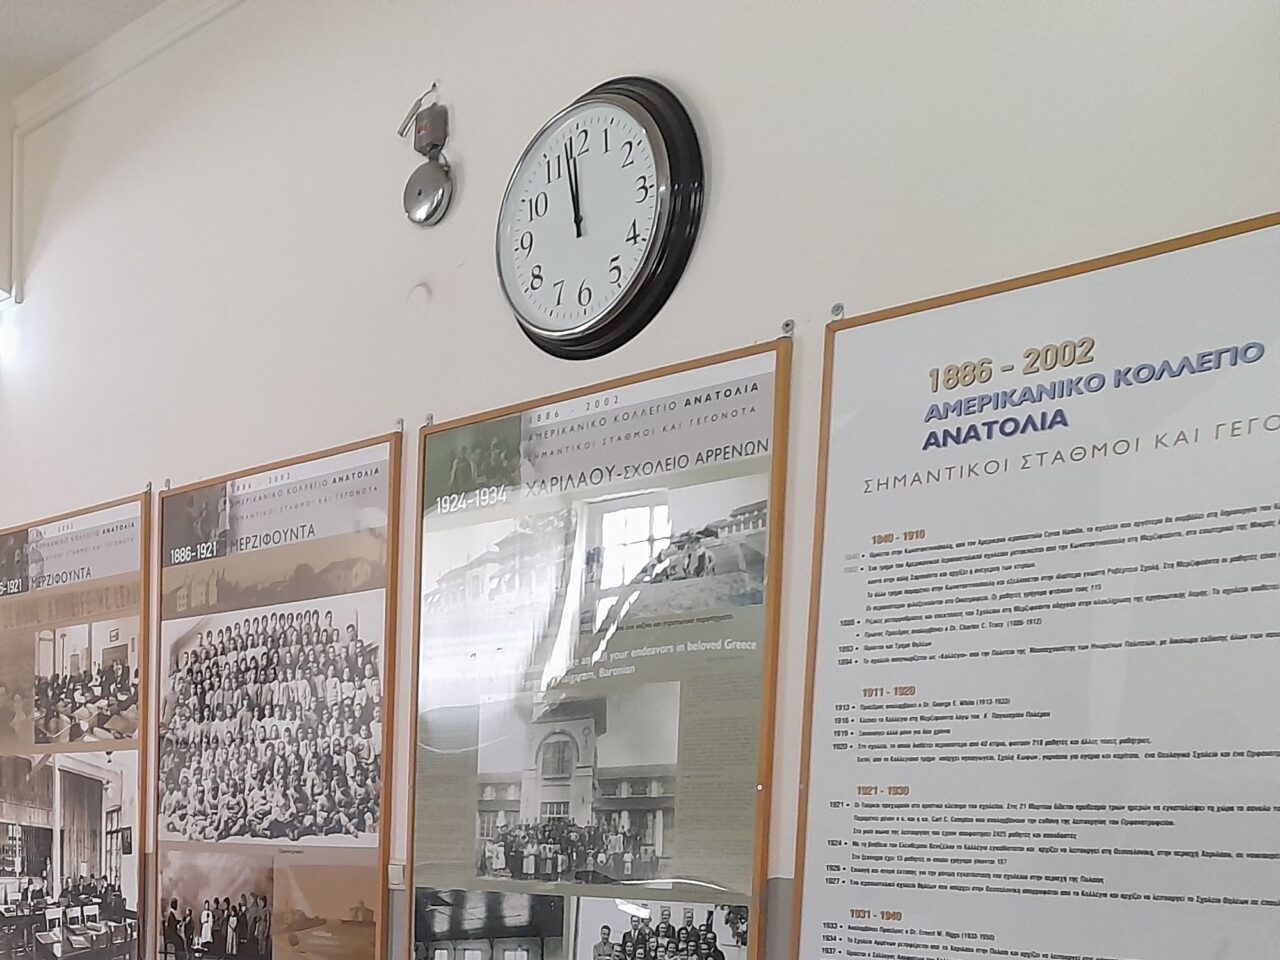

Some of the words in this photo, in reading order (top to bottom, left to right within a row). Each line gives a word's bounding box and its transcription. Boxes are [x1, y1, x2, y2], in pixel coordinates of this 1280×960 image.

[569, 127, 590, 160] 12
[602, 127, 610, 153] 1
[621, 140, 634, 168] 2
[546, 152, 562, 184] 11
[635, 176, 648, 204] 3
[527, 191, 548, 222] 10
[520, 231, 533, 259] 9
[625, 217, 640, 247] 4
[530, 264, 543, 290] 8
[609, 255, 622, 284] 5
[553, 279, 564, 306] 7
[578, 279, 592, 306] 6
[929, 357, 993, 392] 1886
[1023, 336, 1096, 375] 2002
[924, 370, 1105, 423] ΑΜΕΡΙΚΑΝΙΚΟ
[1113, 341, 1265, 389] ΚΟΛΛΕΓΙΟ
[586, 395, 619, 410] 2002
[614, 401, 677, 424] ΚΟΛΛΕΓΙΟ
[683, 382, 759, 407] ΑΝΑΤΟΛΙΑ
[922, 409, 1069, 451] ΑΝΑΤΟΛΙΑ
[694, 438, 769, 465] ΑΡΡΕΝΩΝ
[863, 458, 1009, 494] ΣΗΜΑΝΤΙΚΟΙ
[1020, 437, 1140, 470] ΣΤΑΘΜΟΙ
[1154, 429, 1200, 450] ΚΑΙ
[332, 467, 380, 484] ΑΝΑΤΟΛΙΑ
[435, 485, 508, 514] 1924-1934
[170, 541, 217, 564] 1886-1921
[631, 644, 674, 658] endeavors
[687, 638, 722, 650] beloved
[724, 637, 757, 650] Greece
[863, 688, 884, 697] 1911
[857, 786, 878, 795] 1921
[850, 909, 871, 919] 1931
